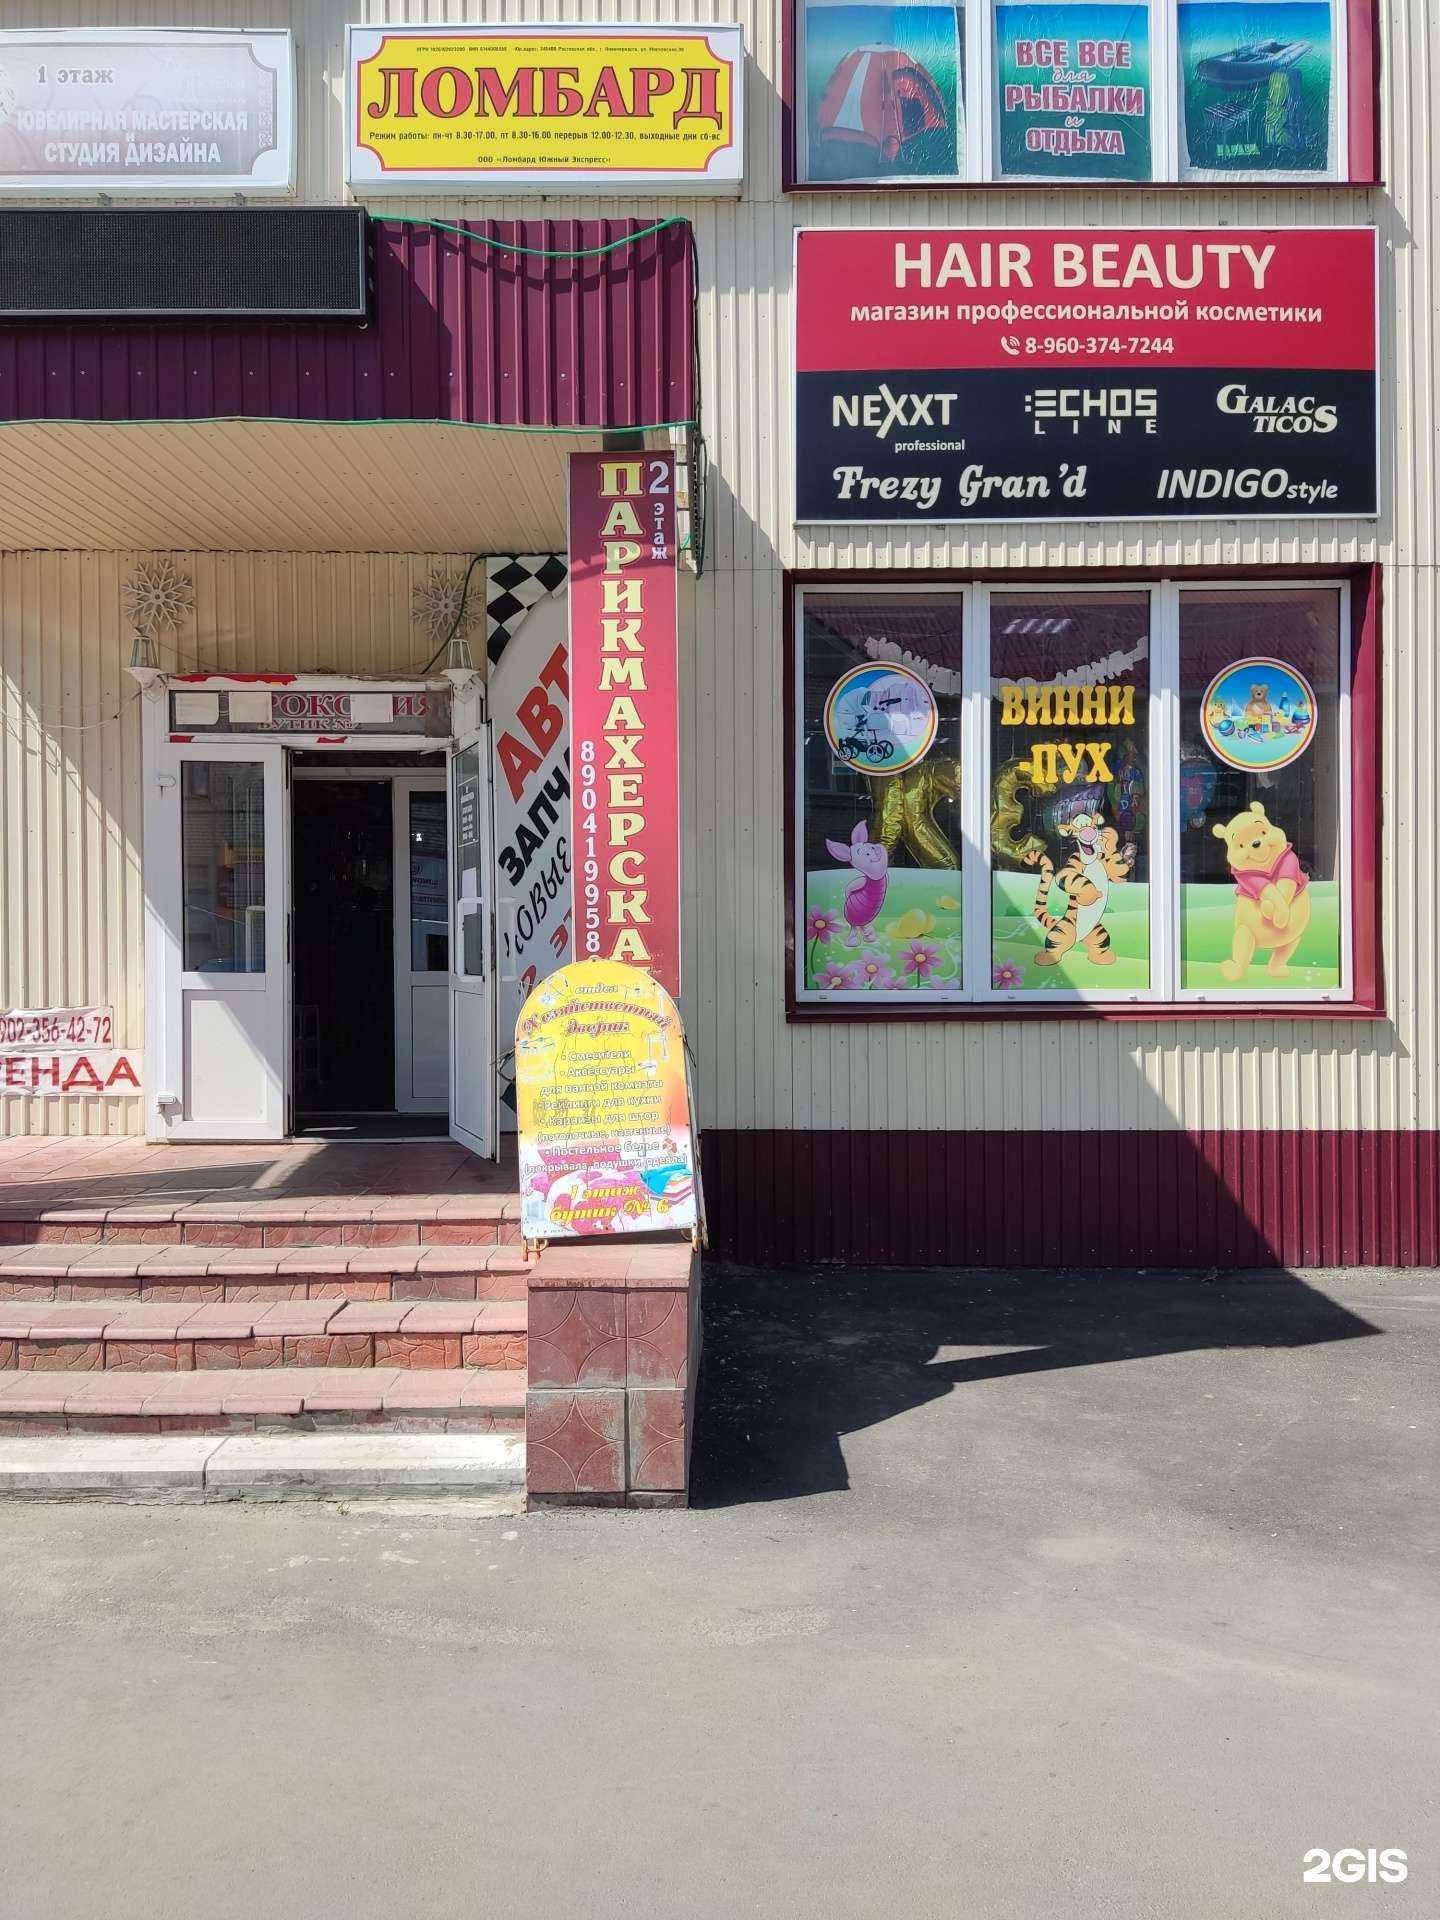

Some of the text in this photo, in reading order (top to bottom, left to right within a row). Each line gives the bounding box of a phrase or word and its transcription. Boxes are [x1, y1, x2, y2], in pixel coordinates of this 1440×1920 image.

[1016, 40, 1131, 69] ВСЕ ВСЕ
[37, 66, 114, 84] 1 этаж
[1052, 68, 1096, 83] для
[367, 66, 723, 130] ЛОМБАРД
[1005, 84, 1145, 116] РЫБАЛКИ
[17, 110, 248, 131] ЮВЕЛИРНАЯ МАСТЕРСКАЯ
[369, 132, 396, 140] Режим
[554, 132, 588, 142] перерыв
[639, 132, 680, 142] выходные
[683, 133, 697, 142] дни
[1026, 128, 1125, 156] ОТДЫХА
[44, 137, 222, 166] СТУДИЯ ДИЗАЙНА
[538, 155, 569, 164] Южный
[895, 243, 1276, 289] HAIR BEAUTY
[850, 299, 1323, 325] магазин профессиональной косметики
[1025, 336, 1175, 354] 8-960-374-7244
[832, 383, 958, 439] NEXXT
[1216, 384, 1316, 414] GALAC
[895, 439, 965, 453] professional
[832, 466, 942, 510] Frezy
[1156, 468, 1339, 504] INDIGO style
[649, 460, 670, 560] 2 этаж
[597, 460, 654, 974] ПАРИКМАХЕРСКА
[1001, 685, 1136, 726] ВИННИ
[498, 746, 571, 887] ЗАПЧ
[580, 740, 601, 962] 890419958
[568, 1050, 633, 1063] Смесители
[0, 1056, 141, 1091] ЕНДА
[566, 1065, 636, 1078] Аксессуары
[540, 1078, 664, 1097] для ванной комнаты
[602, 1098, 625, 1110] для
[627, 1096, 662, 1109] кухни
[604, 1113, 626, 1125] для
[629, 1111, 659, 1124] штор
[551, 1143, 622, 1157] Постельное
[656, 1199, 669, 1214] 6
